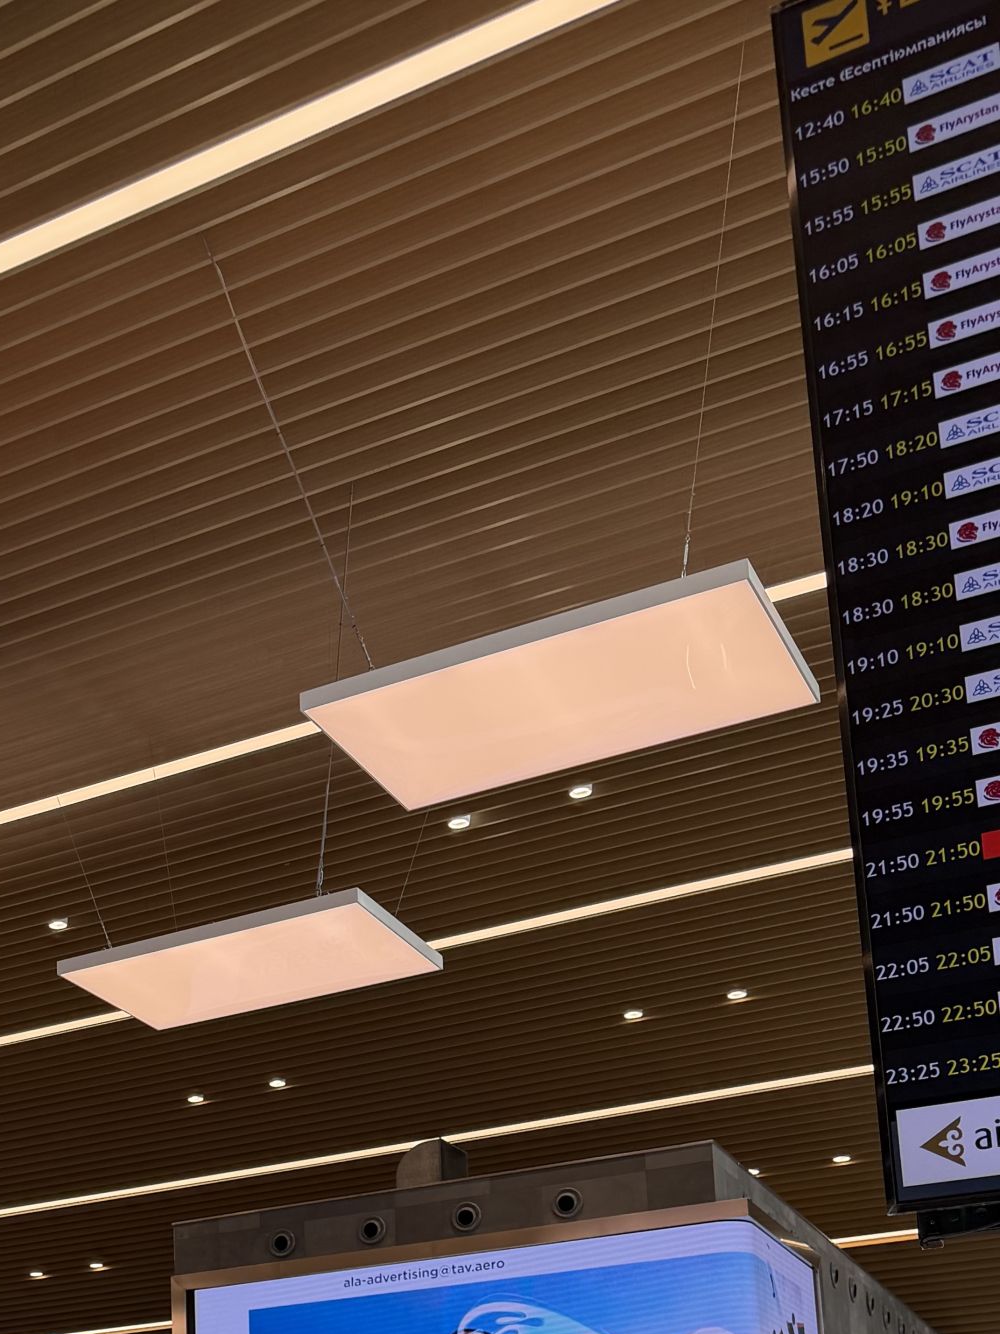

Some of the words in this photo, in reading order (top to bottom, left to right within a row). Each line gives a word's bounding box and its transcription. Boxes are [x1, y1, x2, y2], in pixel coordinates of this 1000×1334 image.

[930, 50, 994, 83] SCAT
[931, 61, 995, 90] AIRLINES
[791, 77, 835, 102] Кесте
[795, 110, 844, 141] 12:40
[851, 87, 902, 120] 16:40
[940, 104, 999, 132] FlyArystan
[800, 158, 850, 188] 15:50
[856, 135, 907, 168] 15:50
[804, 205, 854, 236] 15:55
[860, 184, 912, 216] 15:55
[809, 253, 859, 284] 16:05
[865, 232, 917, 264] 16:05
[814, 302, 864, 332] 16:15
[870, 281, 922, 313] 16:15
[818, 350, 868, 379] 16:55
[875, 331, 927, 361] 16:55
[823, 400, 873, 428] 17:15
[880, 380, 932, 411] 17:15
[828, 449, 879, 477] 17:50
[885, 431, 938, 460] 18:20
[833, 499, 884, 526] 18:20
[890, 481, 943, 510] 19:10
[838, 548, 889, 575] 18:30
[895, 531, 948, 560] 18:30
[842, 599, 894, 625] 18:30
[900, 582, 954, 610] 18:30
[847, 649, 899, 675] 19:10
[905, 633, 959, 661] 19:10
[852, 699, 904, 725] 19:25
[910, 685, 964, 712] 20:30
[857, 750, 909, 776] 19:35
[915, 736, 969, 763] 19:35
[862, 801, 914, 826] 19:55
[920, 788, 975, 815] 19:55
[865, 853, 920, 878] 21:50
[925, 840, 980, 866] 21:50
[870, 905, 925, 929] 21:50
[930, 893, 986, 918] 21:50
[875, 957, 930, 981] 22:05
[935, 946, 991, 970] 22:05
[880, 1009, 935, 1033] 22:50
[941, 999, 997, 1023] 22:50
[886, 1061, 941, 1085] 23:25
[946, 1052, 1000, 1076] 23:25
[343, 1260, 505, 1288] ala-advertising@tav.aero
